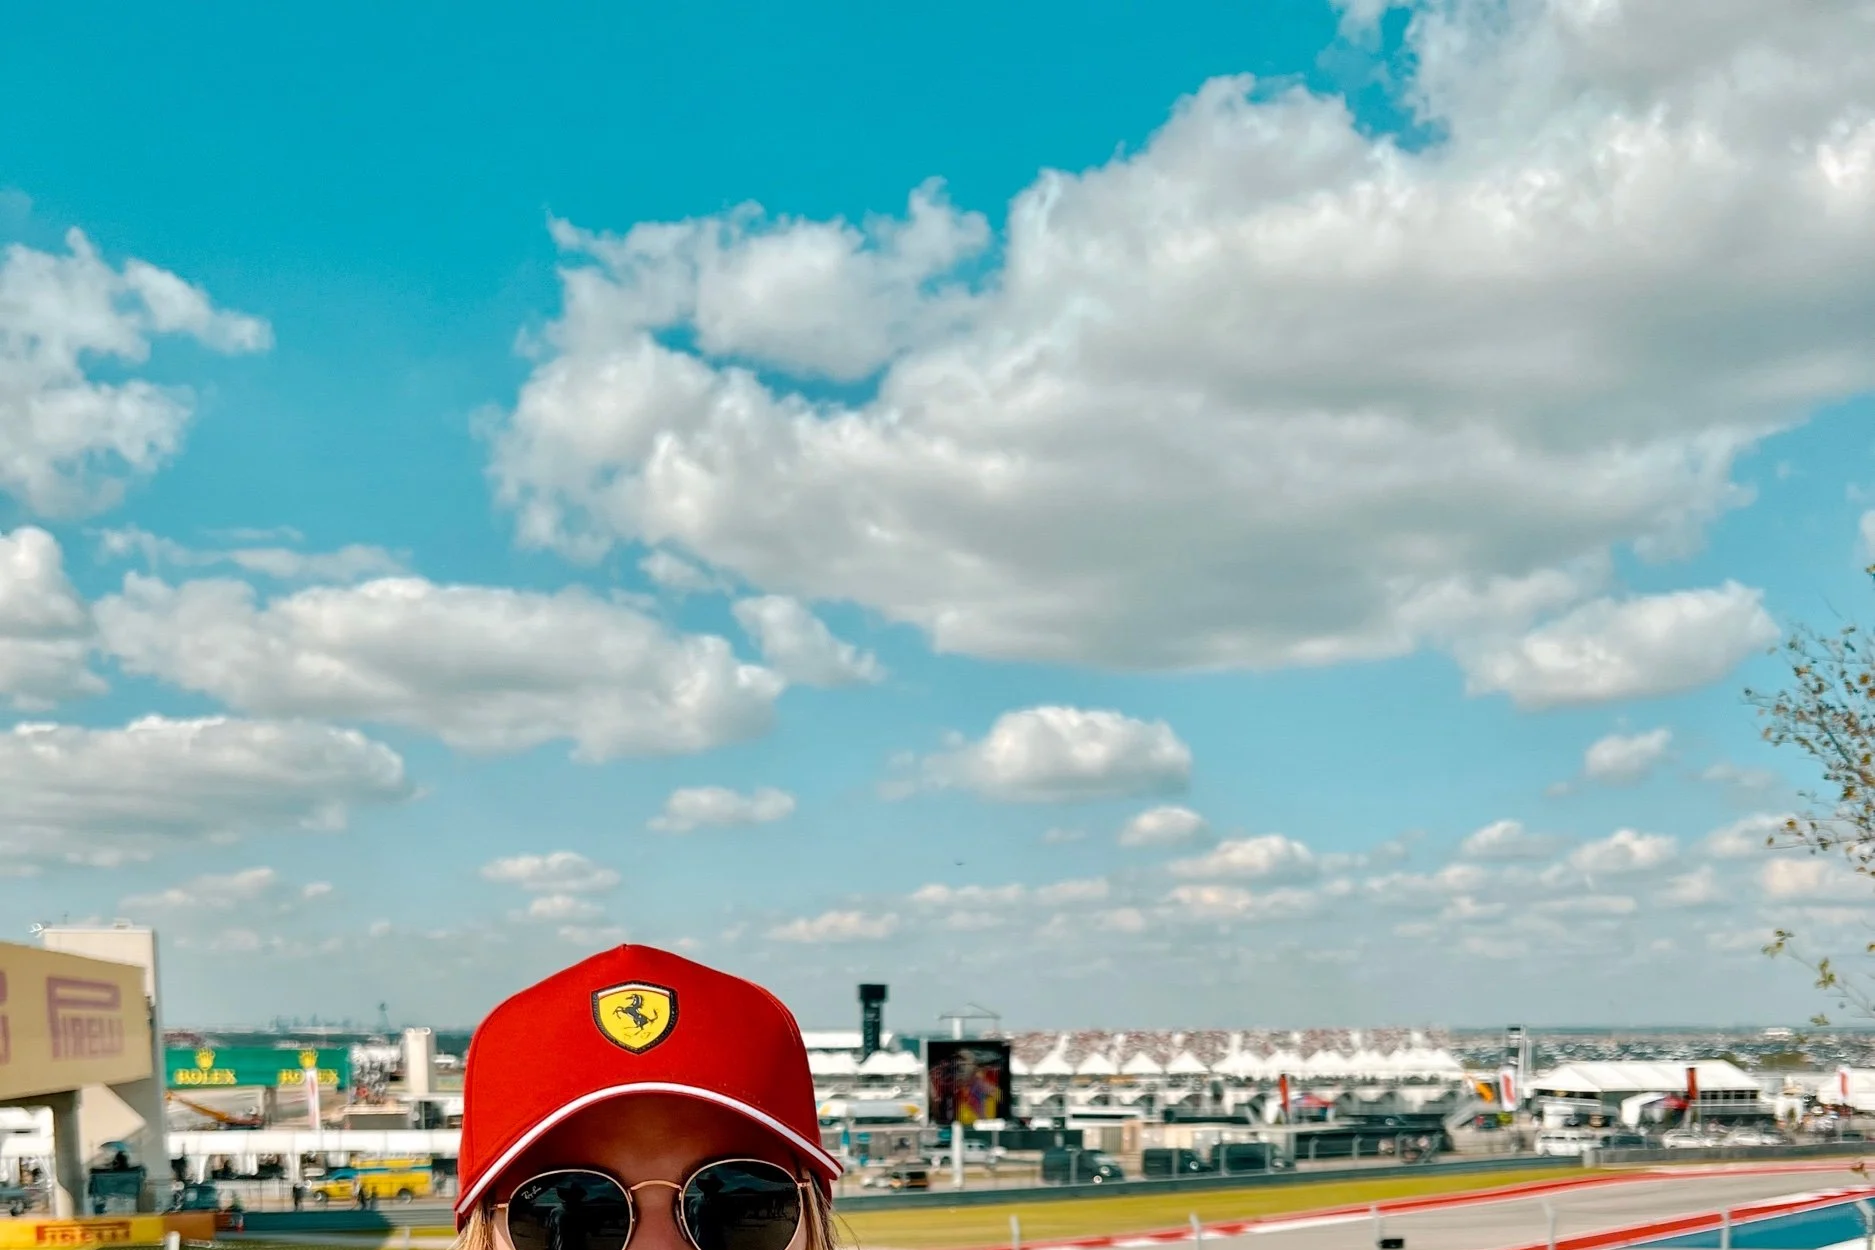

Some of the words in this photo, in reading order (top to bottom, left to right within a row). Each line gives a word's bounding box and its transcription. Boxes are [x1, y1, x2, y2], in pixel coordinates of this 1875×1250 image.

[46, 975, 124, 1060] PIRELLI
[174, 1068, 238, 1085] ROLEX
[278, 1068, 340, 1085] ROEX
